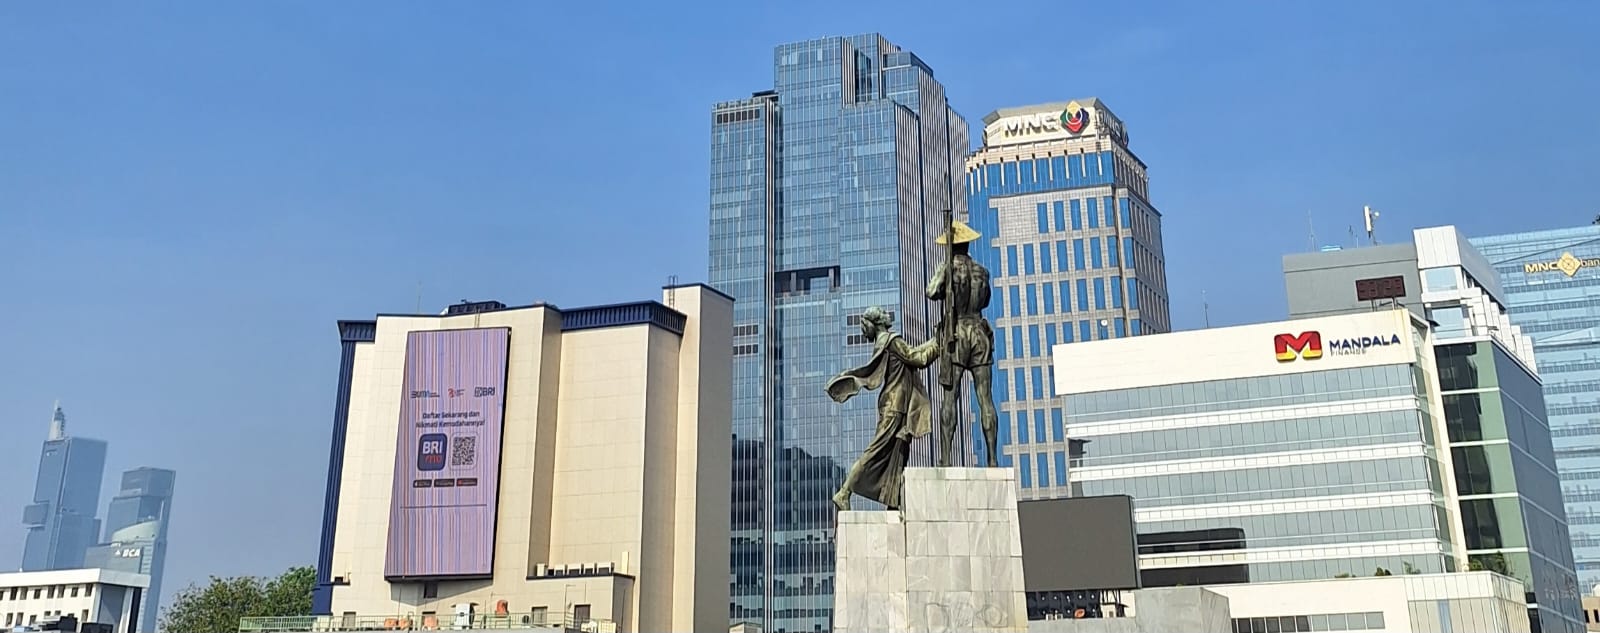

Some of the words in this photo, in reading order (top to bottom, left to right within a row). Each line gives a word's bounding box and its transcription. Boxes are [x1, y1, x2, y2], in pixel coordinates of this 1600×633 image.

[1004, 111, 1060, 138] MNC
[1524, 261, 1560, 273] MNC
[1580, 258, 1600, 268] ban
[1329, 334, 1401, 351] MANDALA
[481, 387, 495, 396] BRI
[442, 411, 467, 419] Sekarang
[422, 441, 443, 454] BRI
[122, 548, 140, 557] BCA
